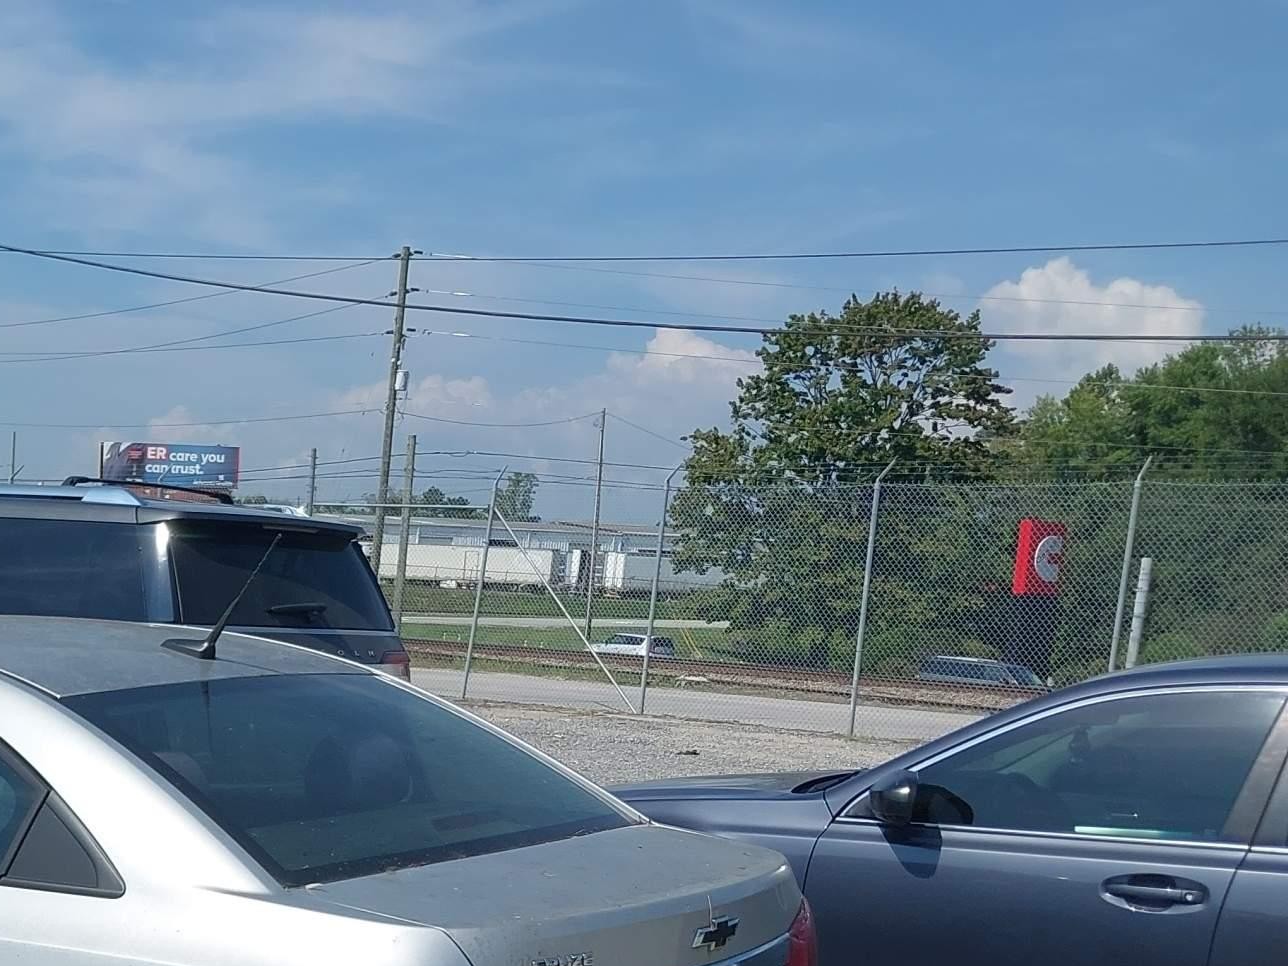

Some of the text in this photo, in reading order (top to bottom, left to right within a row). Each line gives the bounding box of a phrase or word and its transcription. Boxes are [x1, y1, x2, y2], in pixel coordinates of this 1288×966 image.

[146, 446, 167, 460] ER
[169, 452, 198, 462] care
[201, 453, 225, 465] you
[144, 463, 204, 475] can trust.
